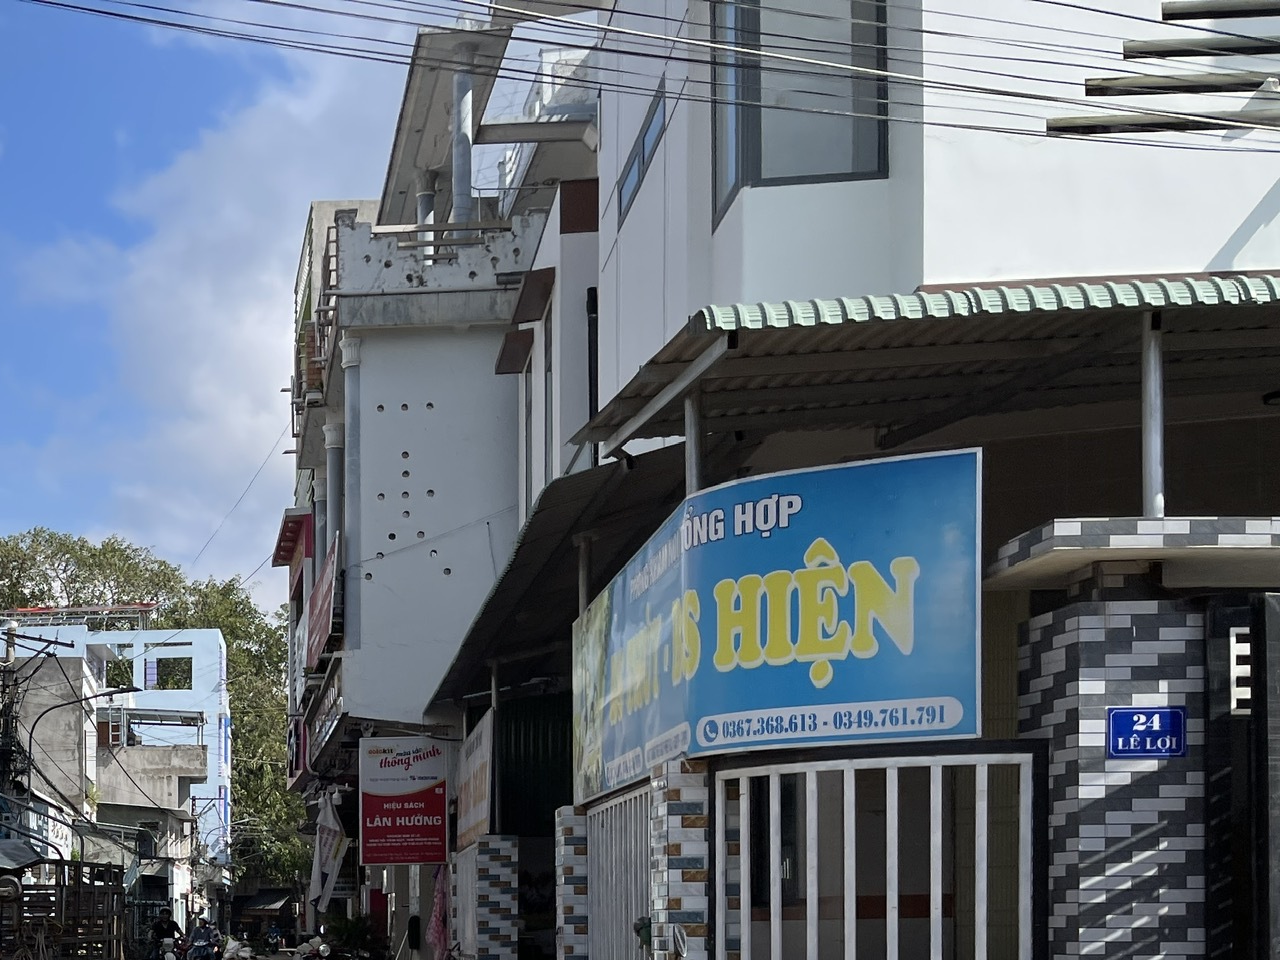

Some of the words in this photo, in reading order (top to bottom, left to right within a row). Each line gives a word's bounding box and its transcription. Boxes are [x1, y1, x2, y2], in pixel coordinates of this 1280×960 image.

[734, 493, 802, 539] HỢP
[713, 538, 920, 689] HIỆN
[722, 712, 818, 740] 0367.368.613
[832, 704, 946, 731] 0349.761.791
[1132, 713, 1161, 731] 24
[1117, 734, 1140, 750] LÊ
[1146, 735, 1177, 752] LỢI
[380, 755, 413, 771] thông
[413, 745, 442, 763] minh
[383, 801, 402, 811] HIỆU
[403, 800, 425, 810] SÁCH
[366, 814, 392, 828] LÂN
[396, 813, 442, 827] HƯỞNG
